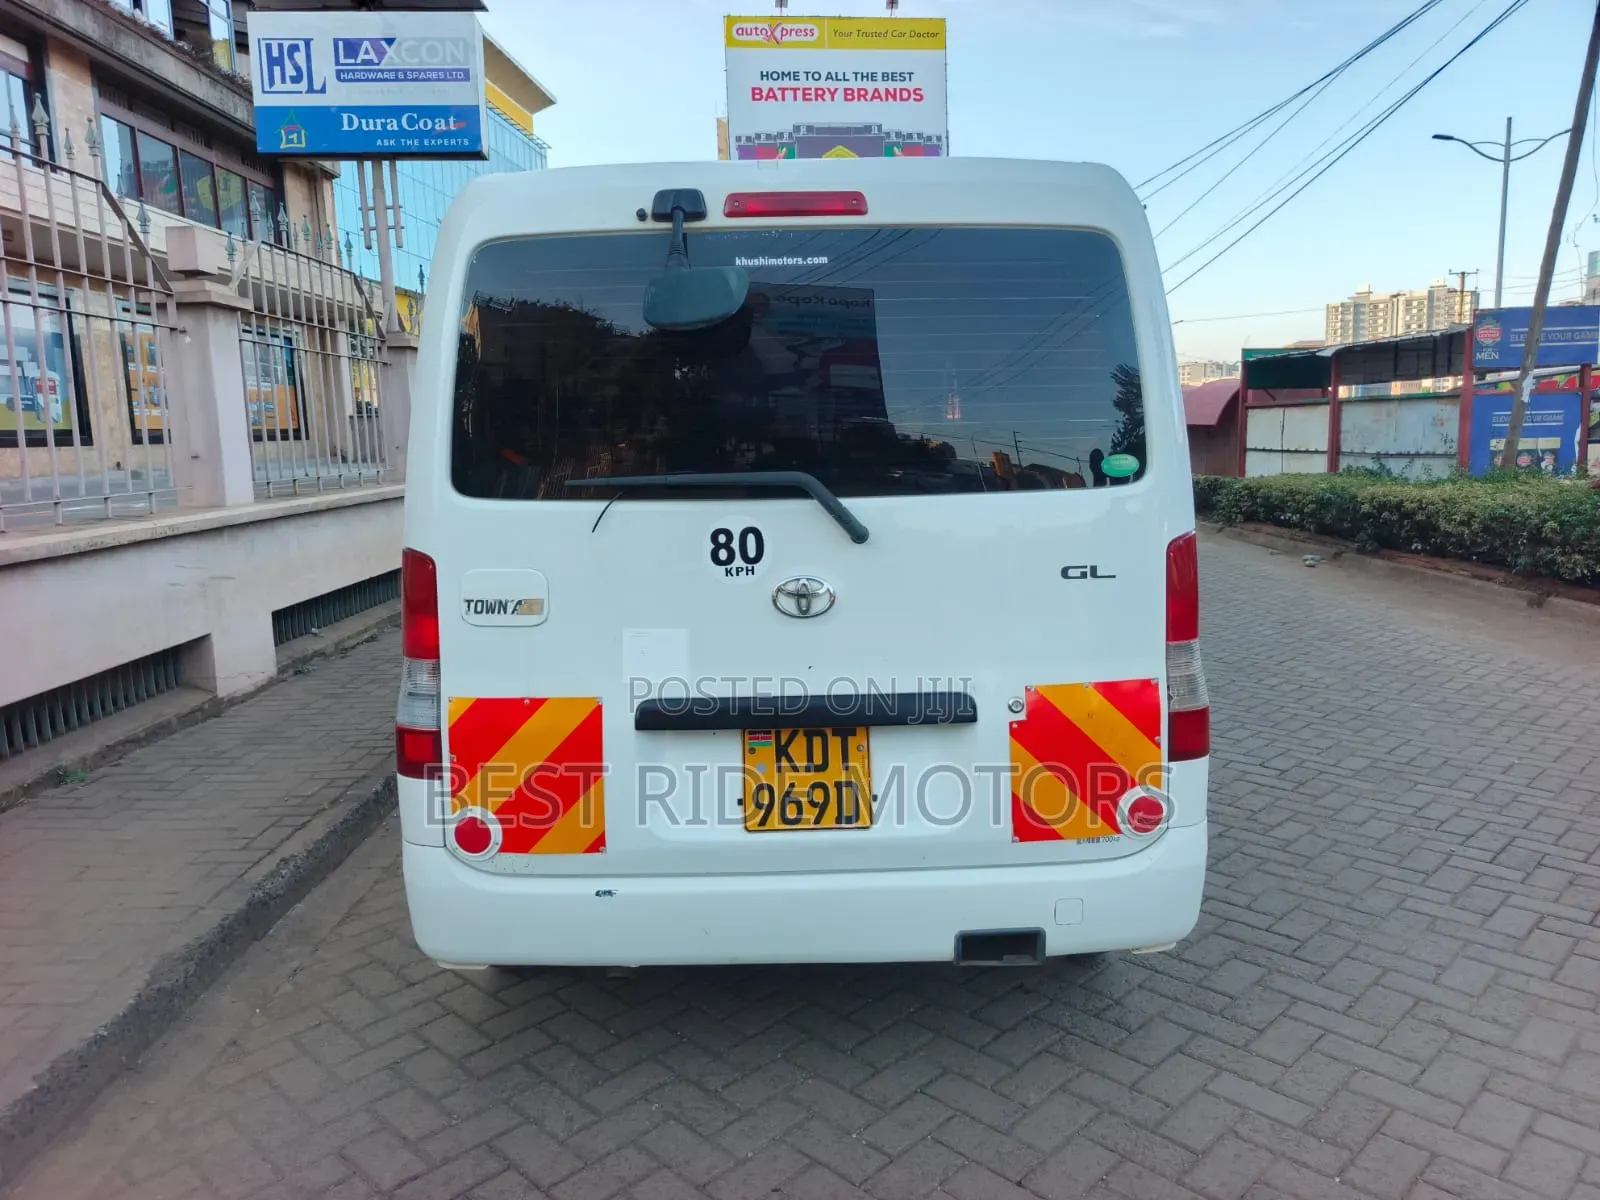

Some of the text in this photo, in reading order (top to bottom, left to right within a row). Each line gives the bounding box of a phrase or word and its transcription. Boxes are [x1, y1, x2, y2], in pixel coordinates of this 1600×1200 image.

[735, 23, 815, 46] autoXpress
[833, 28, 940, 39] Your Trusted Car Doctor
[337, 39, 465, 65] LAXCON
[340, 72, 396, 80] HARDWARE
[406, 72, 445, 80] SPARES
[446, 72, 466, 80] LTD.
[760, 70, 914, 82] HOME TO ALL THE BEST
[751, 87, 924, 102] BATTERY BRANDS
[376, 138, 470, 146] ASK THE EXPERTS
[735, 256, 829, 267] khushimotors.com
[1548, 332, 1573, 341] YOUR
[1476, 351, 1500, 361] MEN
[710, 526, 765, 567] 80
[724, 566, 755, 577] KPH
[1060, 565, 1117, 580] GL
[774, 728, 858, 774] KDT
[752, 780, 861, 828] 969D
